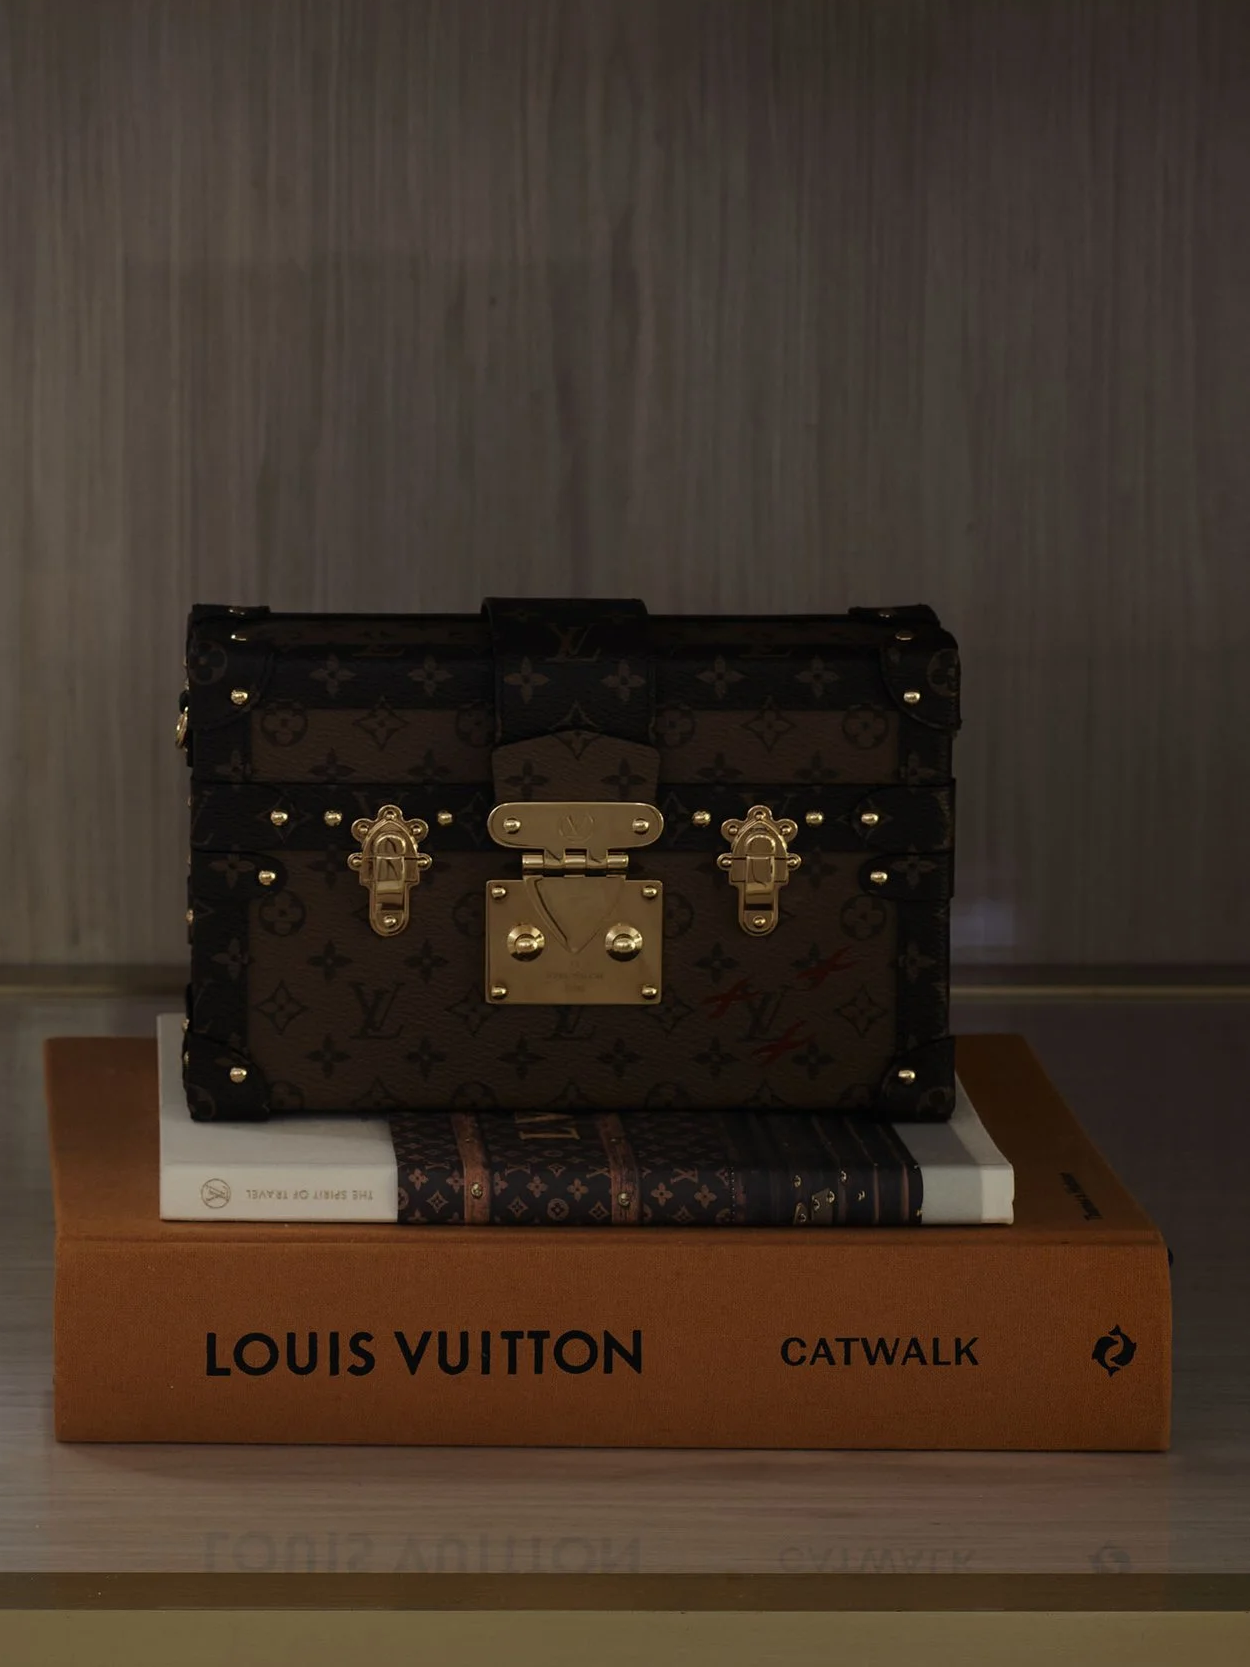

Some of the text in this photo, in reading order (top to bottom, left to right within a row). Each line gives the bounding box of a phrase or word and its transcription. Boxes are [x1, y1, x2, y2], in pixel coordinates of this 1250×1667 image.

[245, 1189, 373, 1201] THE SPIRIT OF TRAVEL
[206, 1329, 979, 1377] LOUIS VUITTON CATWALK
